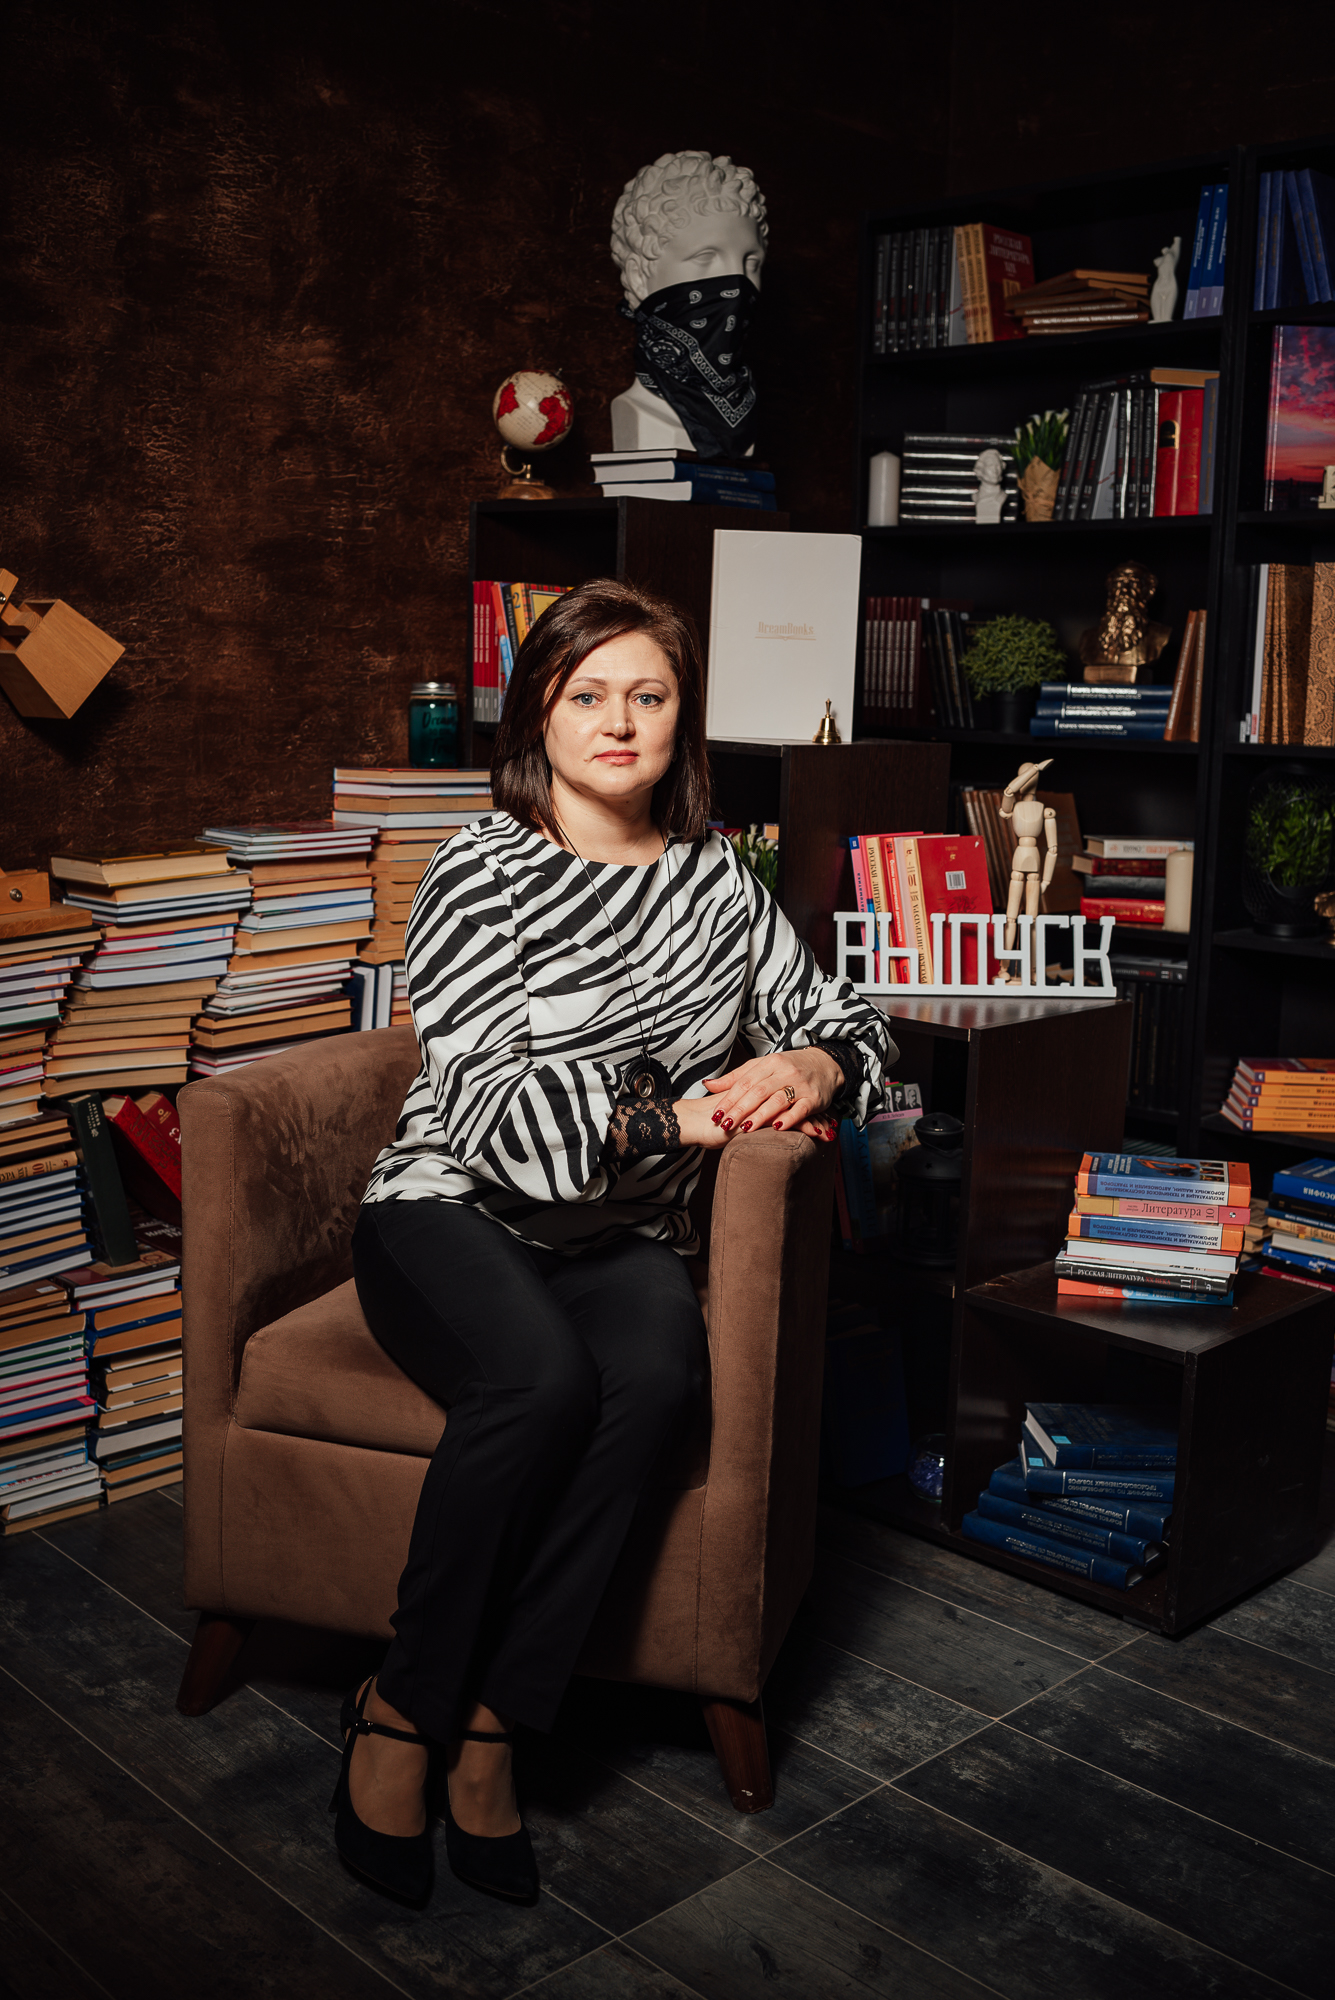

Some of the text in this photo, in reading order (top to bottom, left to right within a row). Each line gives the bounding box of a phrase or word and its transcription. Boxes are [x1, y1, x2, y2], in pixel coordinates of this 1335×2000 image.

[759, 622, 814, 635] DreamBooks
[868, 847, 878, 878] РУССКАЯ
[913, 904, 924, 950] ЛИТЕРАТУРА
[833, 911, 1116, 997] ВЫПУСК
[918, 953, 927, 984] РУССКАЯ
[32, 1163, 44, 1175] 10
[1104, 1187, 1145, 1195] ОБСЛУЖИВАНИЕ
[1135, 1183, 1171, 1191] АВТОМОБИЛЕЙ
[1146, 1189, 1180, 1197] ТЕХНИЧЕСКОЕ
[1186, 1192, 1225, 1201] ЭКСПЛУАТАЦИЯ
[1195, 1188, 1225, 1196] ДОРОЖНЫХ
[1141, 1202, 1215, 1219] Литература 10
[1093, 1224, 1121, 1232] ТРАКТОРОВ
[1128, 1227, 1164, 1235] АВТОМОБИЛЕЙ
[1097, 1230, 1138, 1239] ОБСЛУЖИВАНИЕ
[1139, 1234, 1172, 1242] ТЕХНИЧЕСКОЕ
[1179, 1238, 1218, 1246] ЭКСПЛУАТАЦИЯ
[1077, 1269, 1105, 1278] РУССКАЯ
[1105, 1271, 1145, 1283] ЛИТЕРАТУРА
[1155, 1277, 1171, 1285] ВЕКА
[1180, 1279, 1192, 1289] 11
[1068, 1478, 1157, 1491] ПРОДОВОЛЬСТВЕННЫХ ТОВАРОВ
[1068, 1485, 1116, 1494] ТОВАРОВЕДЕНИЮ
